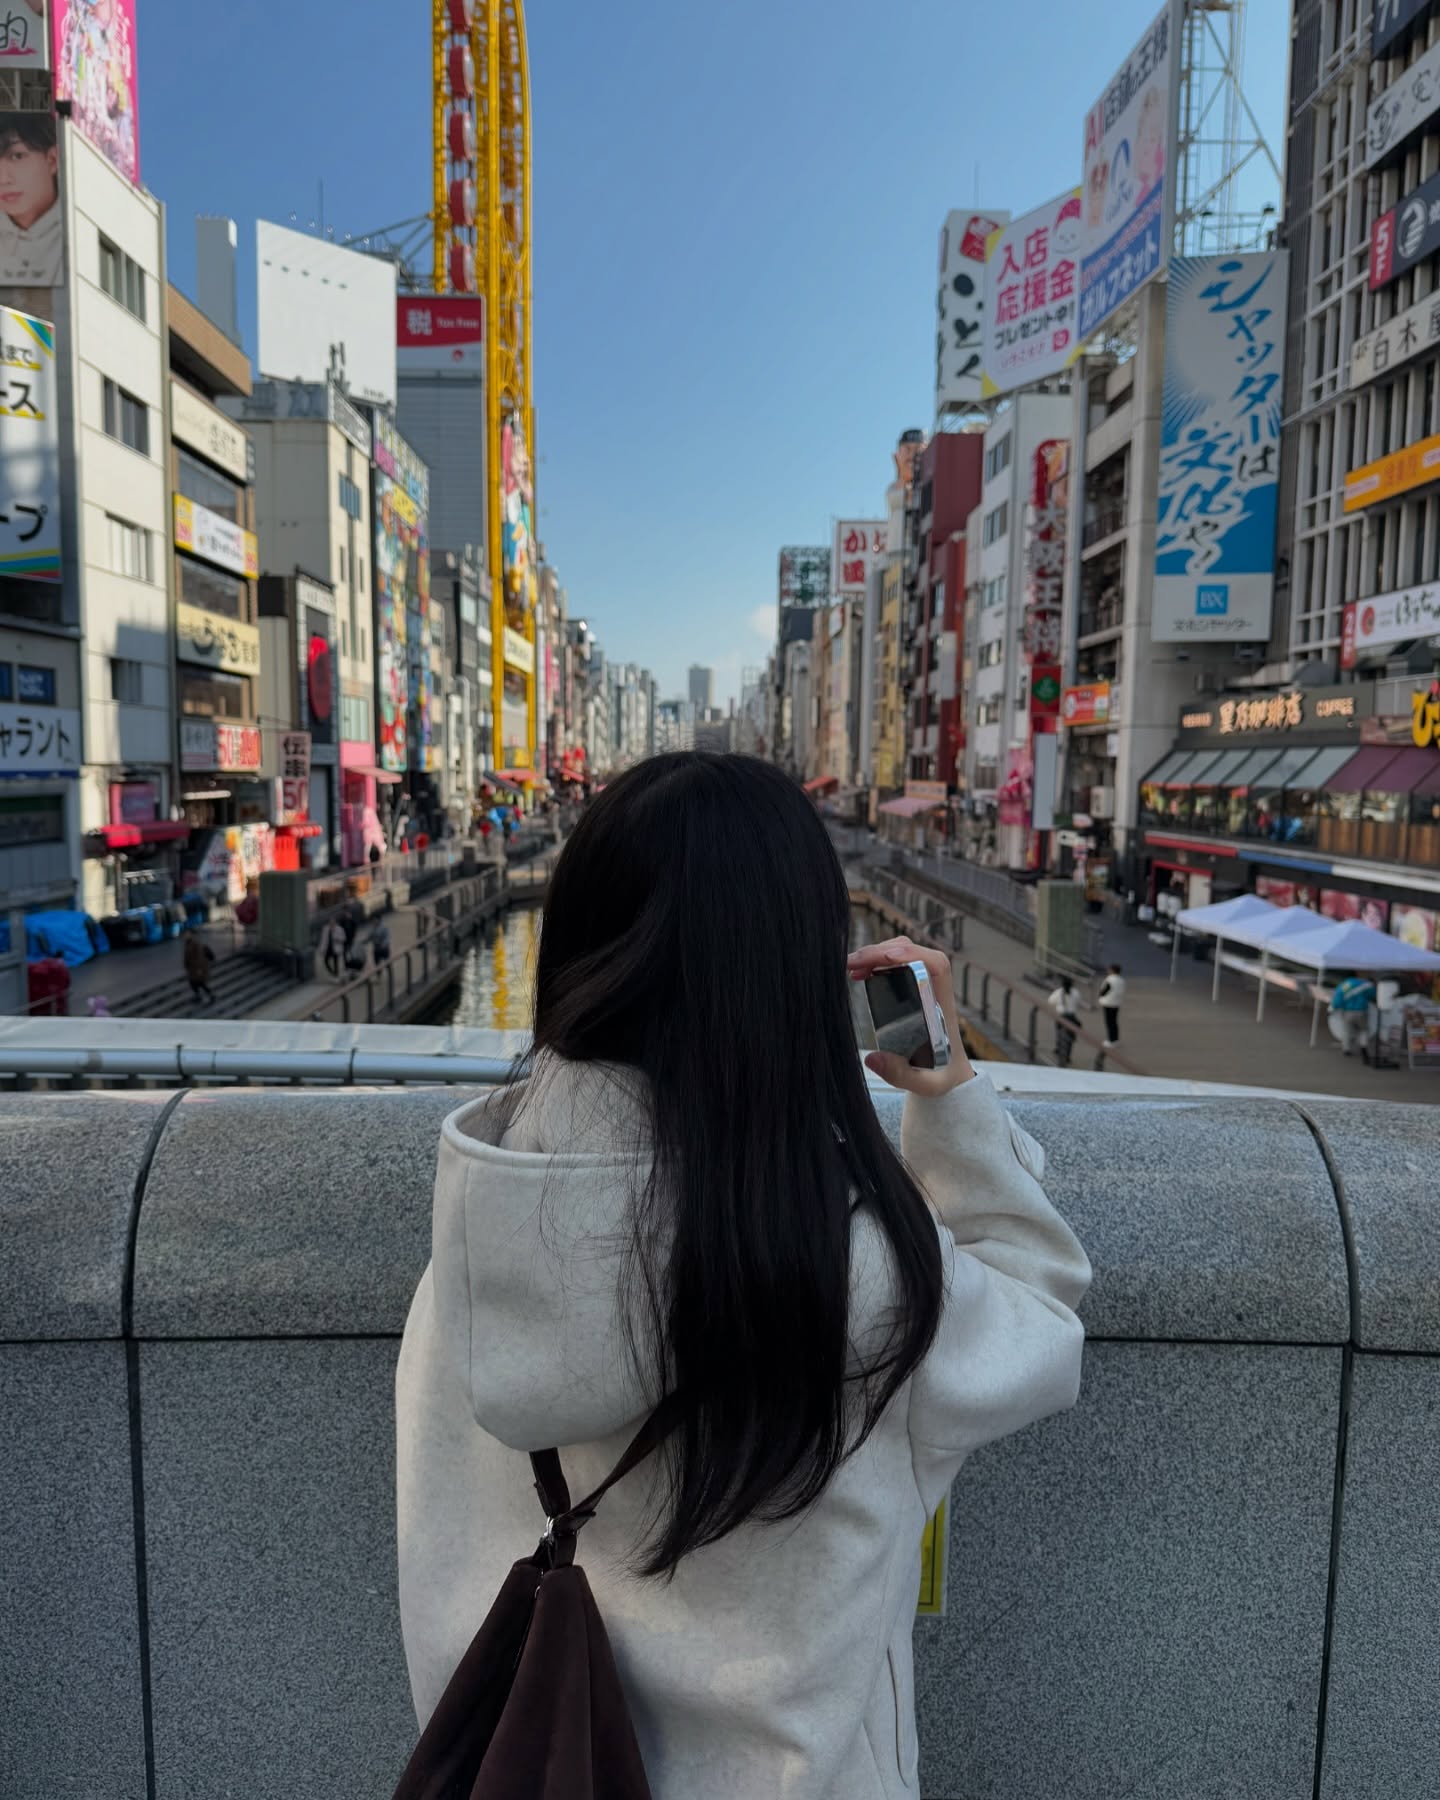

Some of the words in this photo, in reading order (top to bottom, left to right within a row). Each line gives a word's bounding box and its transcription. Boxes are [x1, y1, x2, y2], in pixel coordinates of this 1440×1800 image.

[997, 226, 1049, 284] 入店
[995, 259, 1075, 325] 応援金
[456, 316, 479, 329] Free
[1197, 259, 1278, 481] シャッターは
[1316, 697, 1354, 718] COFFEE
